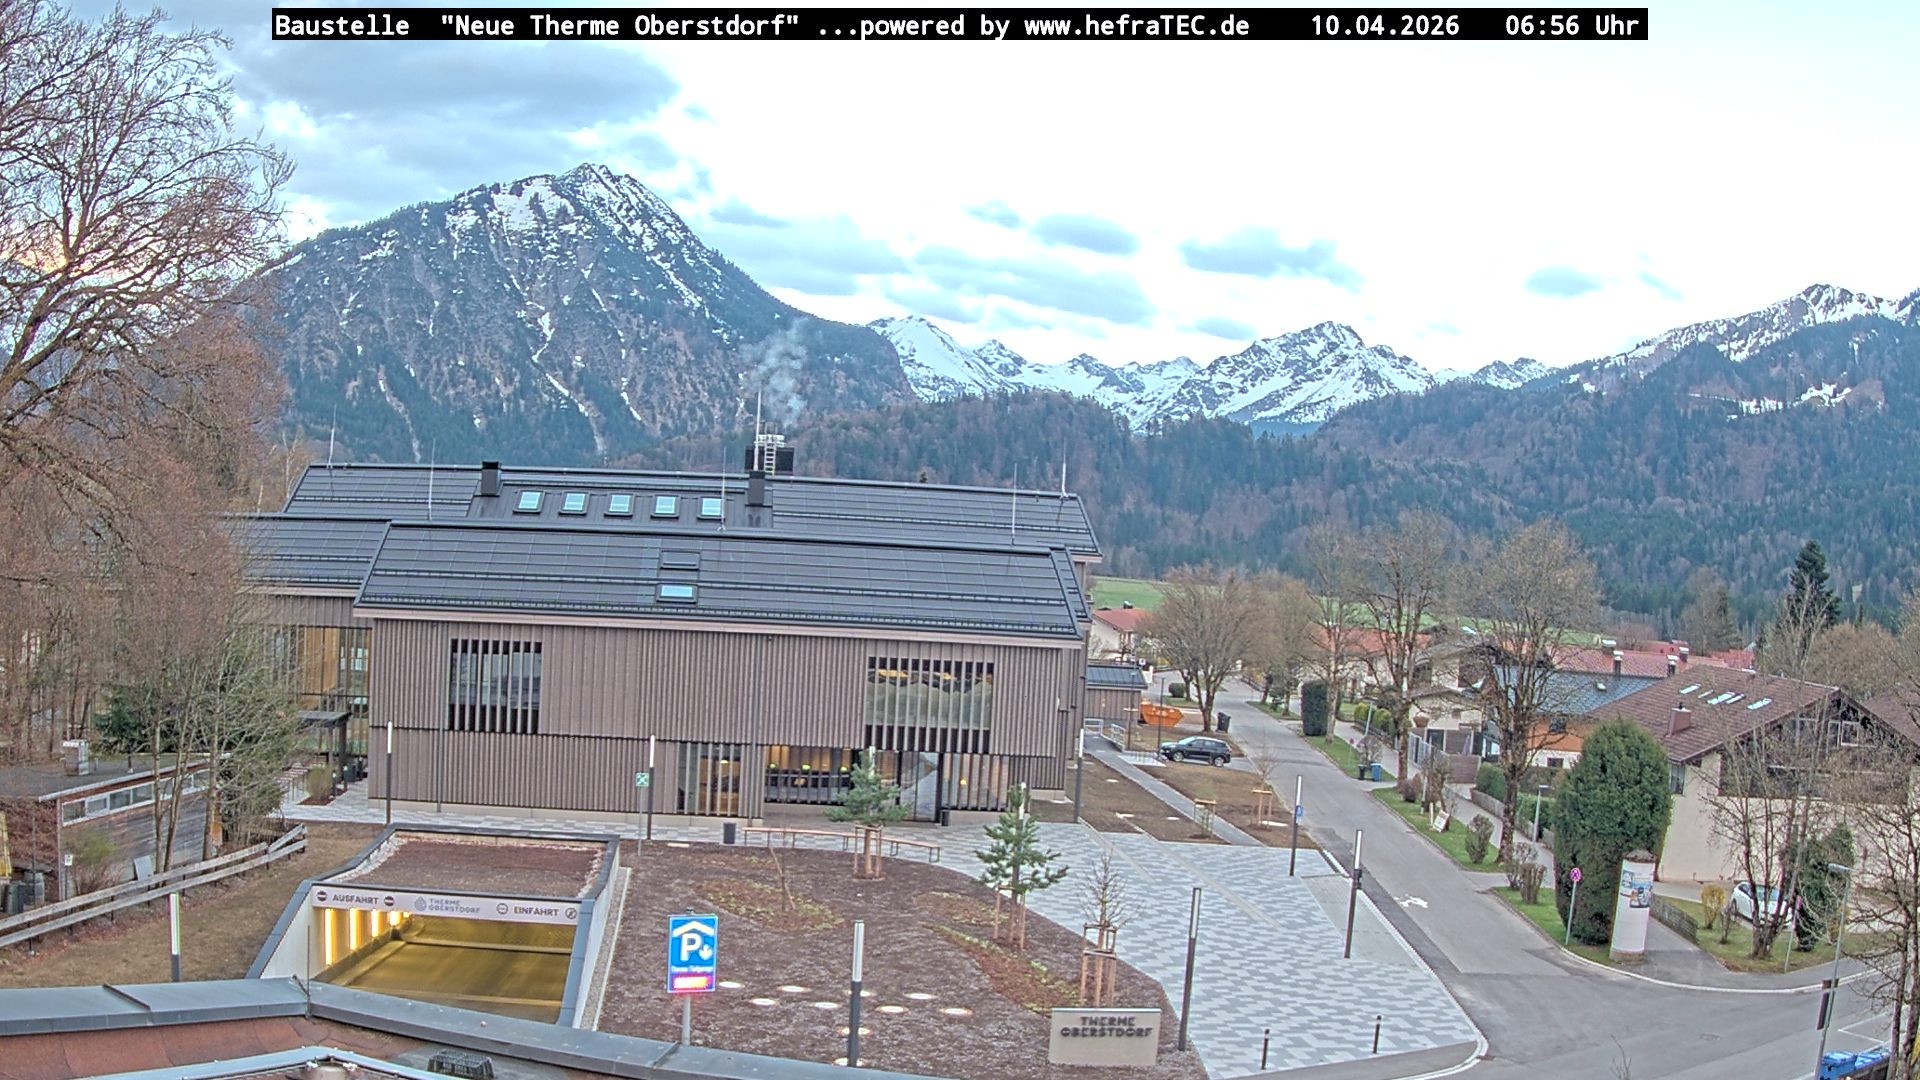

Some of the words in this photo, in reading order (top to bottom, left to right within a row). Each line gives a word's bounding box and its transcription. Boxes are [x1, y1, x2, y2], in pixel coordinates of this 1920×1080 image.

[332, 894, 379, 905] AUSFAHRT
[513, 906, 560, 917] EINFAHRT
[680, 933, 702, 962] P
[1080, 1016, 1136, 1027] THERME
[1060, 1027, 1153, 1038] OBERSTDORF
